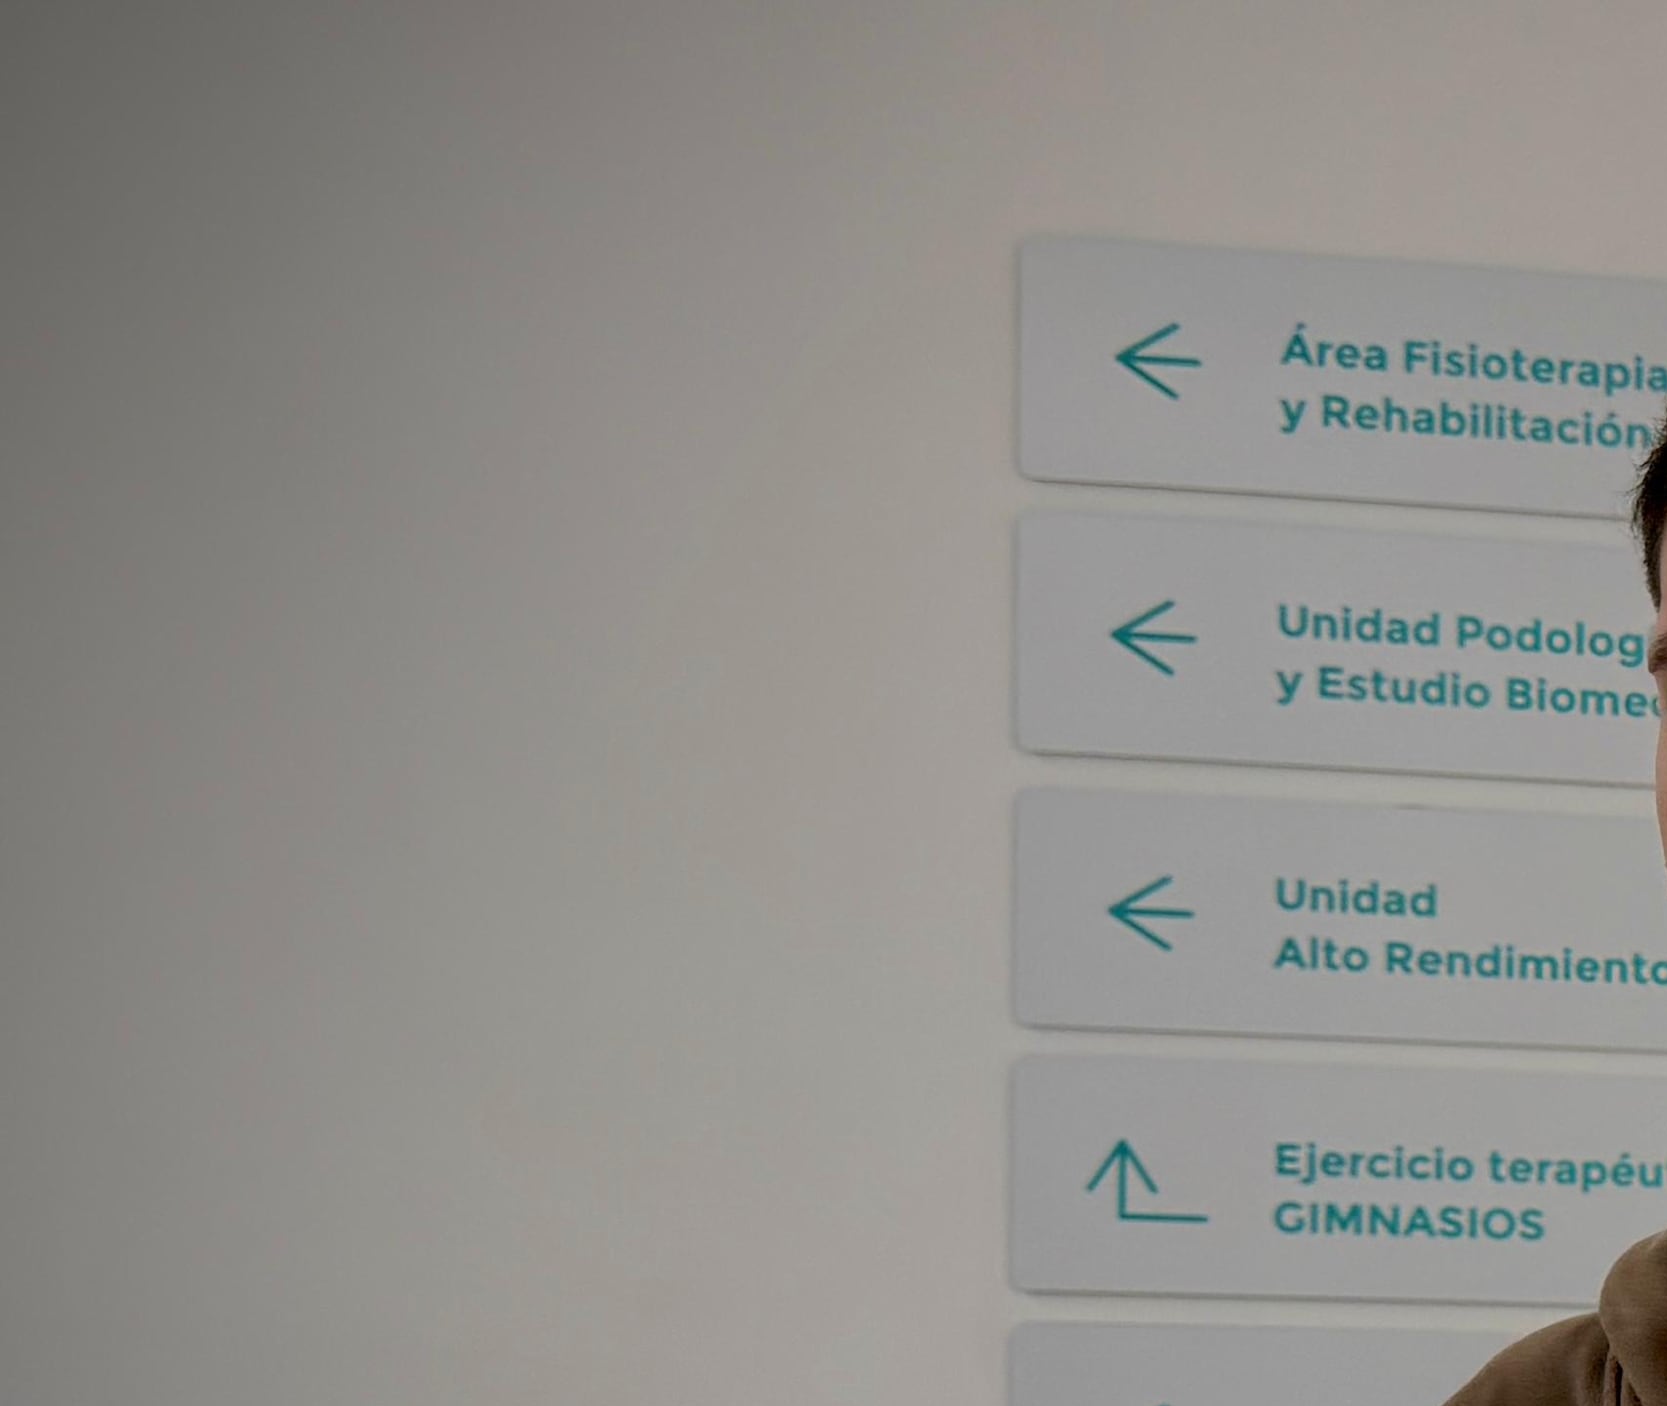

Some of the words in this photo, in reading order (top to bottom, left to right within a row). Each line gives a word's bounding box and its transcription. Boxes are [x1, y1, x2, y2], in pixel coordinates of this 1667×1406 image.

[1281, 323, 1389, 374] Área
[1280, 399, 1308, 436] y
[1320, 394, 1654, 449] Rehabilitación
[1278, 603, 1443, 648] Unidad
[1456, 614, 1647, 670] Podolog
[1277, 672, 1304, 708] y
[1316, 665, 1493, 710] Estudio
[1275, 878, 1440, 921] Unidad
[1274, 937, 1372, 975] Alto
[1275, 1142, 1477, 1190] Ejercicio
[1273, 1200, 1547, 1244] GIMNASIOS
